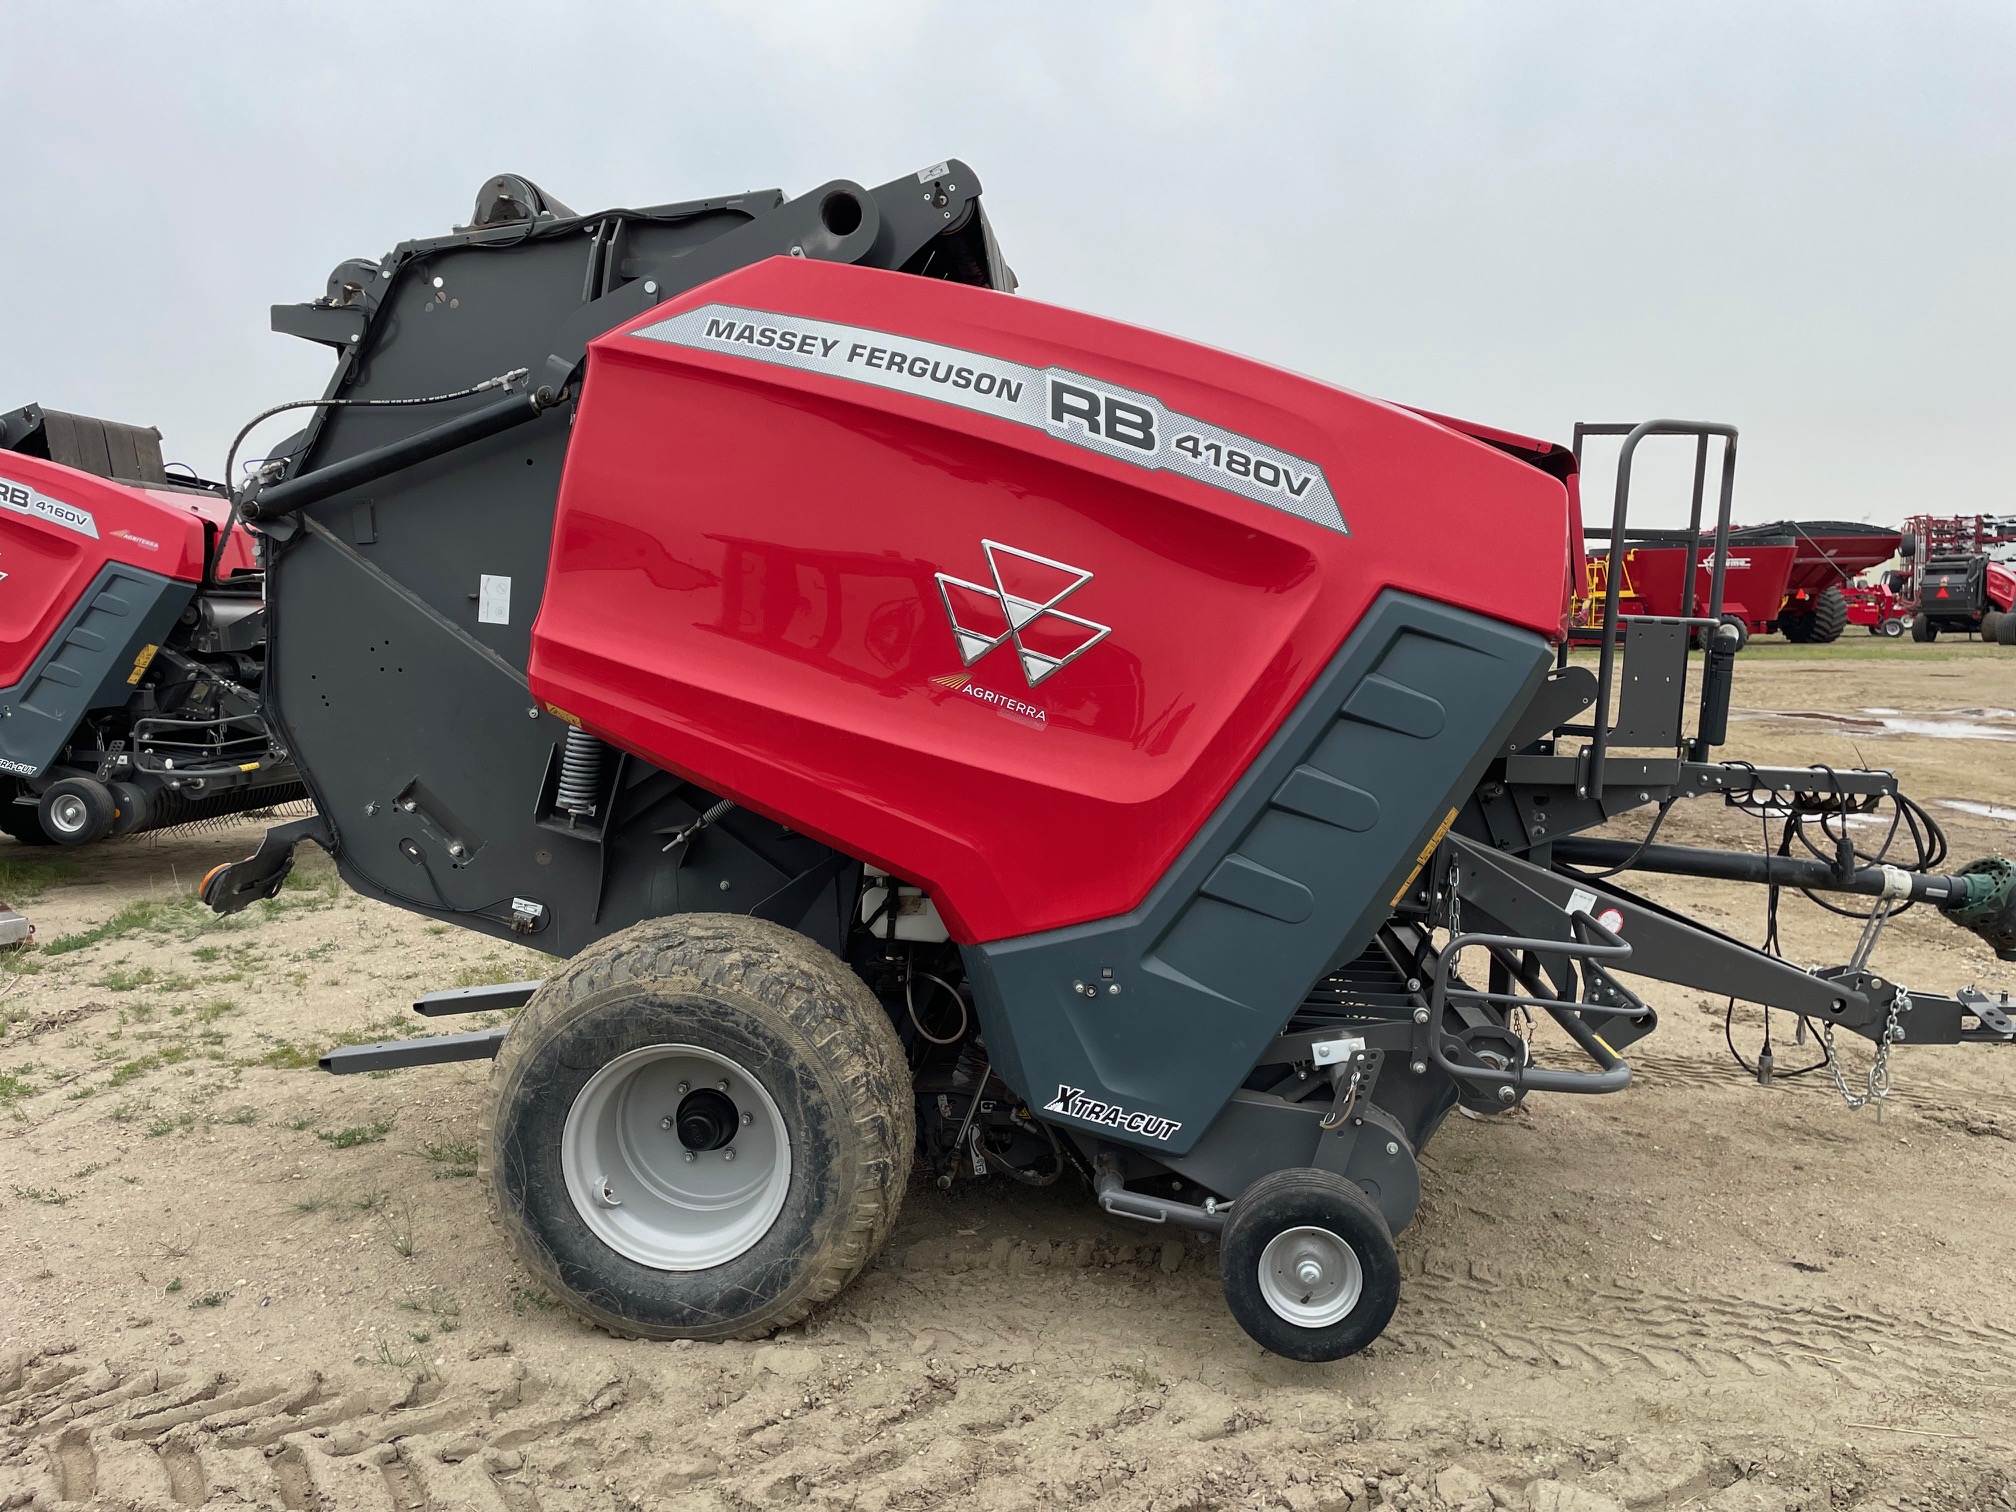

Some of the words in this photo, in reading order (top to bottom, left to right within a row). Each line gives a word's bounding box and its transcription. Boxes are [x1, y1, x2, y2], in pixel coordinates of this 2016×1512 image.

[705, 318, 840, 358] MASSEY
[847, 342, 1023, 403] FERGUSON
[1051, 379, 1156, 451] RB
[1175, 434, 1312, 497] 4180V
[36, 501, 88, 526] 4160V
[962, 683, 1046, 722] AGRITERRA
[1044, 1084, 1182, 1141] XTRA-CUT
